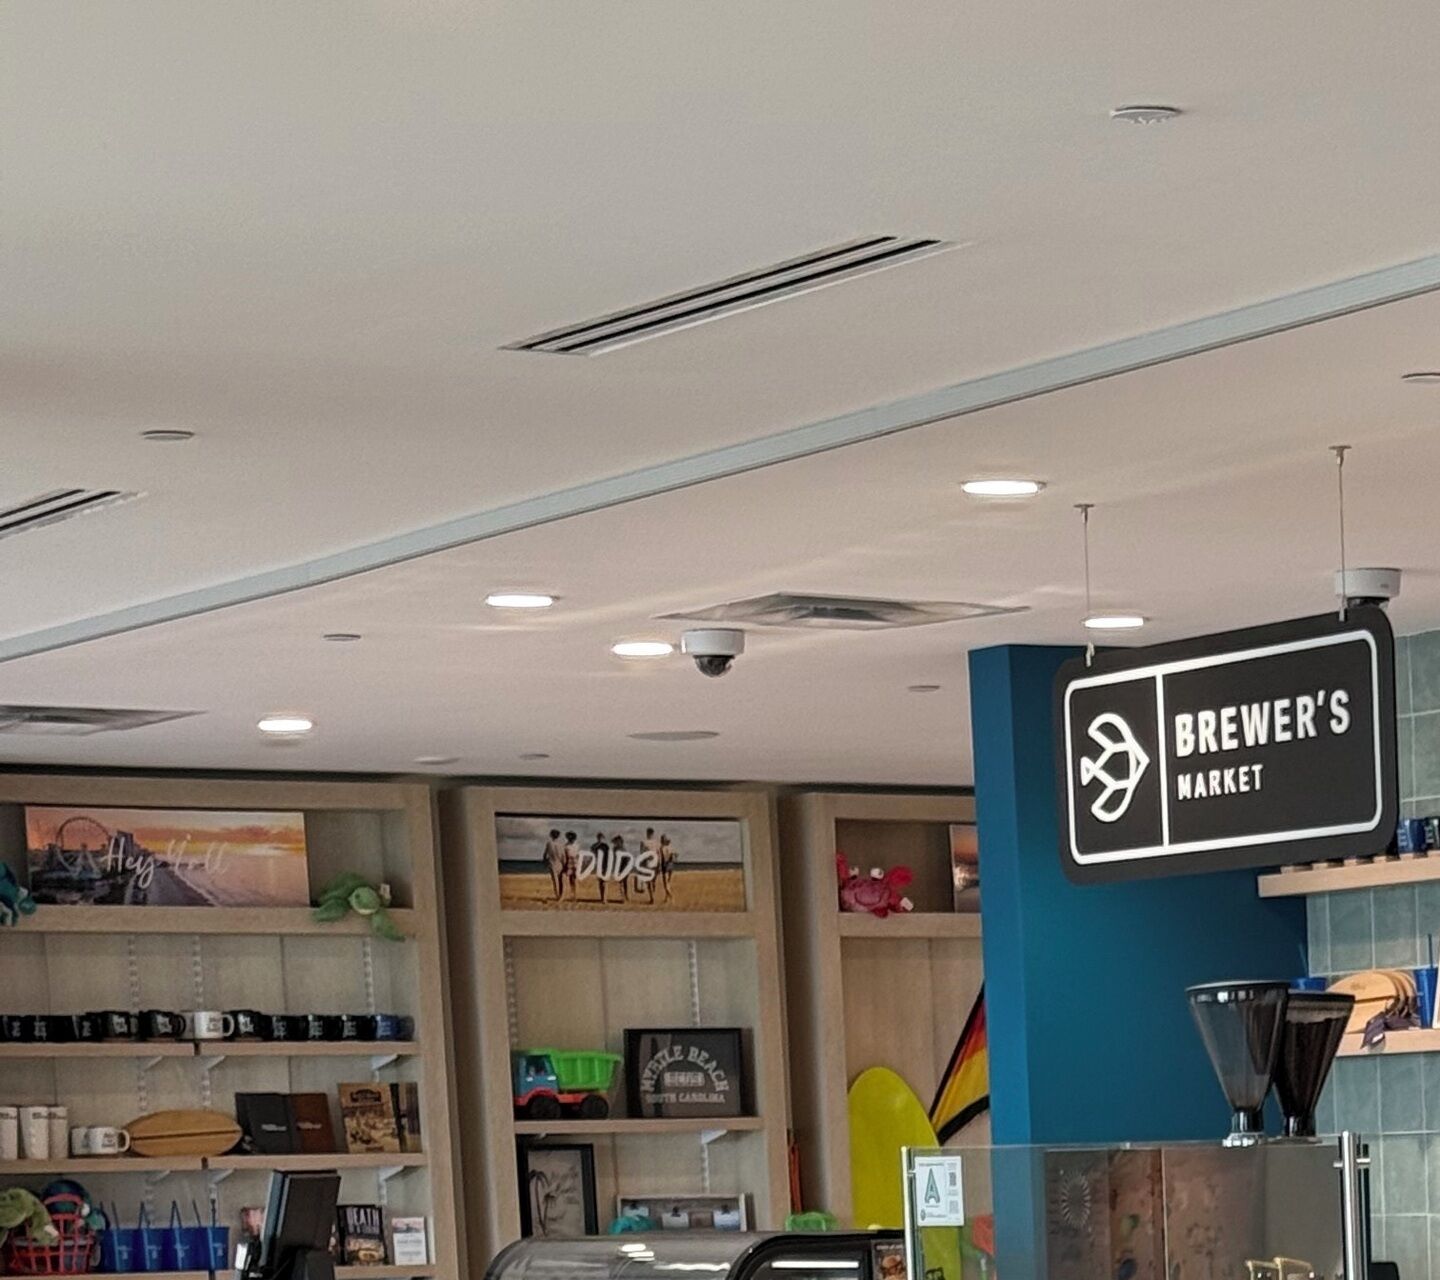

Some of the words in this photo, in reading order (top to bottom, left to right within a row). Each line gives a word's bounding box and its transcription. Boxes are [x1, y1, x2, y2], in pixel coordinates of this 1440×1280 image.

[1174, 689, 1350, 758] BREWER'S
[1177, 764, 1264, 801] MARKET
[101, 836, 156, 888] Hey
[576, 850, 658, 882] DUDS
[641, 1045, 685, 1092] MYRTLE
[687, 1046, 730, 1092] BEACH
[678, 1092, 726, 1103] CAROLINA
